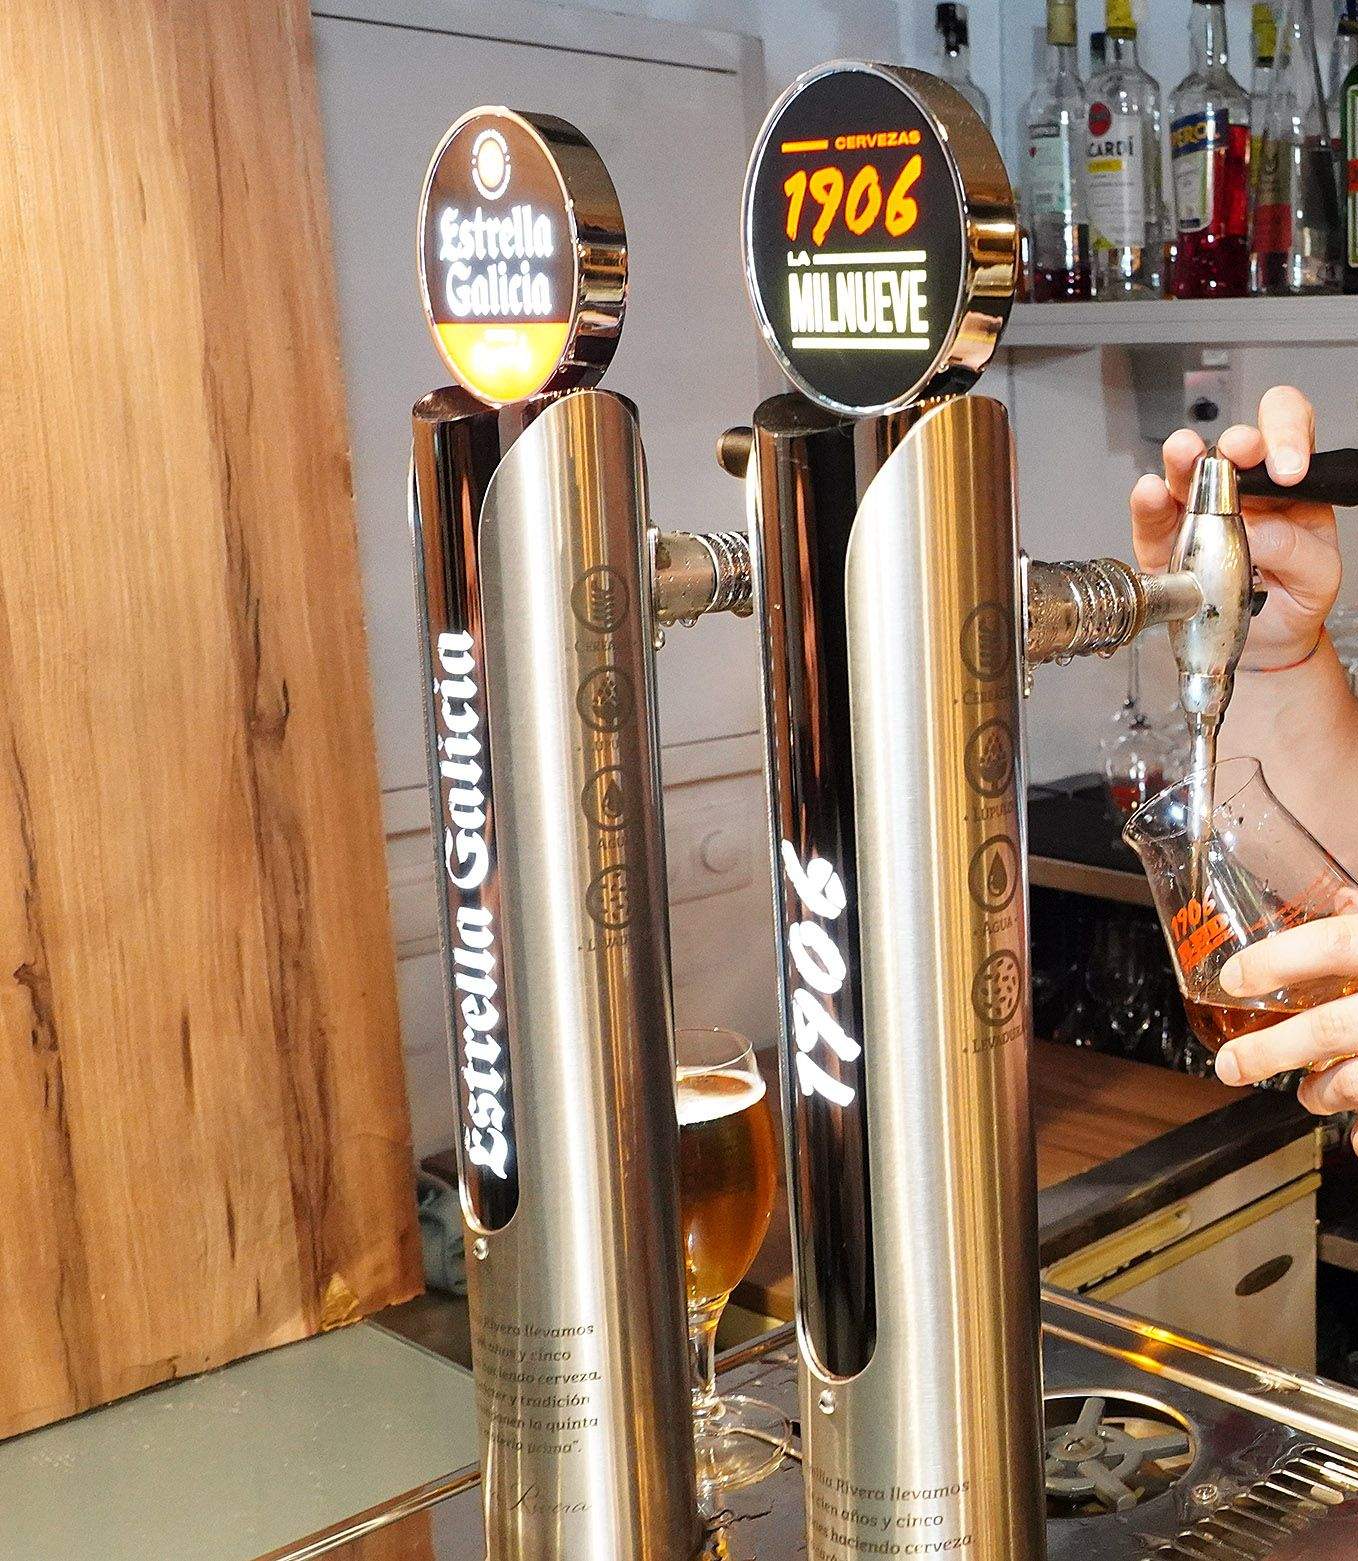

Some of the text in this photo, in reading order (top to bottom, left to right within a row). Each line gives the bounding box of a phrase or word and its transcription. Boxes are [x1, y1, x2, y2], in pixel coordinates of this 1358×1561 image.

[834, 130, 922, 151] CERVEZAS
[783, 153, 923, 248] 1906
[439, 203, 555, 262] Estrella
[787, 250, 811, 267] LA
[445, 259, 553, 317] Galicia
[788, 269, 930, 334] MILNUEVE
[434, 629, 509, 1180] Estrella Galicia
[1170, 885, 1217, 942] 1906
[781, 837, 862, 1107] 1906
[524, 1322, 595, 1339] llevamos
[538, 1371, 602, 1386] cerveza.
[546, 1417, 599, 1434] quinta
[836, 1479, 885, 1501] Rivera
[889, 1480, 971, 1502] llevamos
[895, 1513, 945, 1529] cinco
